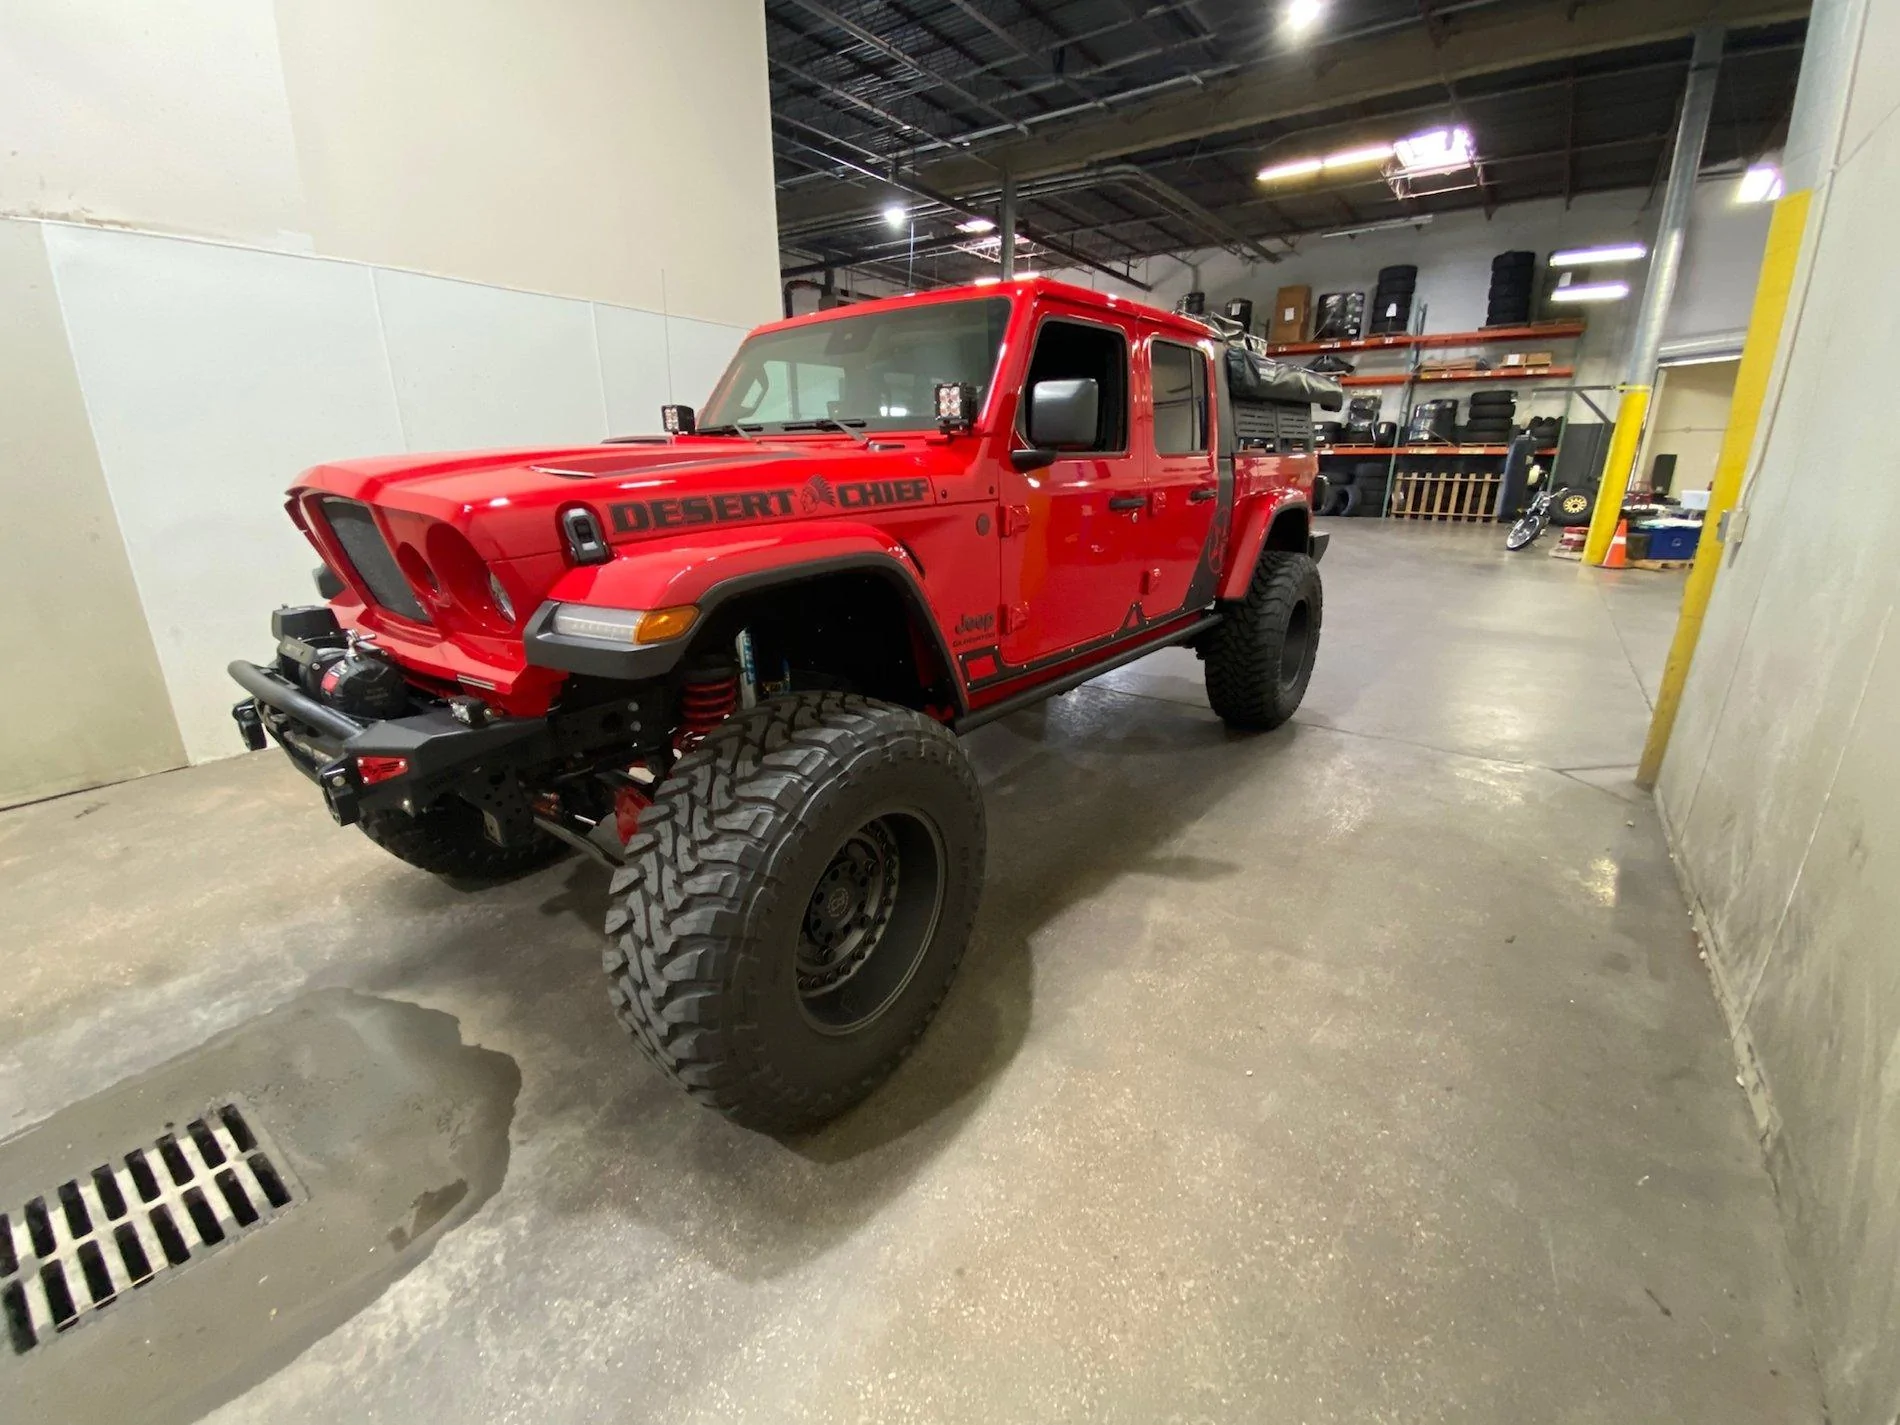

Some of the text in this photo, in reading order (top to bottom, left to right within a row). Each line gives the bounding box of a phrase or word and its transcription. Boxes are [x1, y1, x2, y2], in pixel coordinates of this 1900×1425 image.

[609, 478, 930, 534] DESERT CHIEF
[955, 613, 994, 635] Jeep
